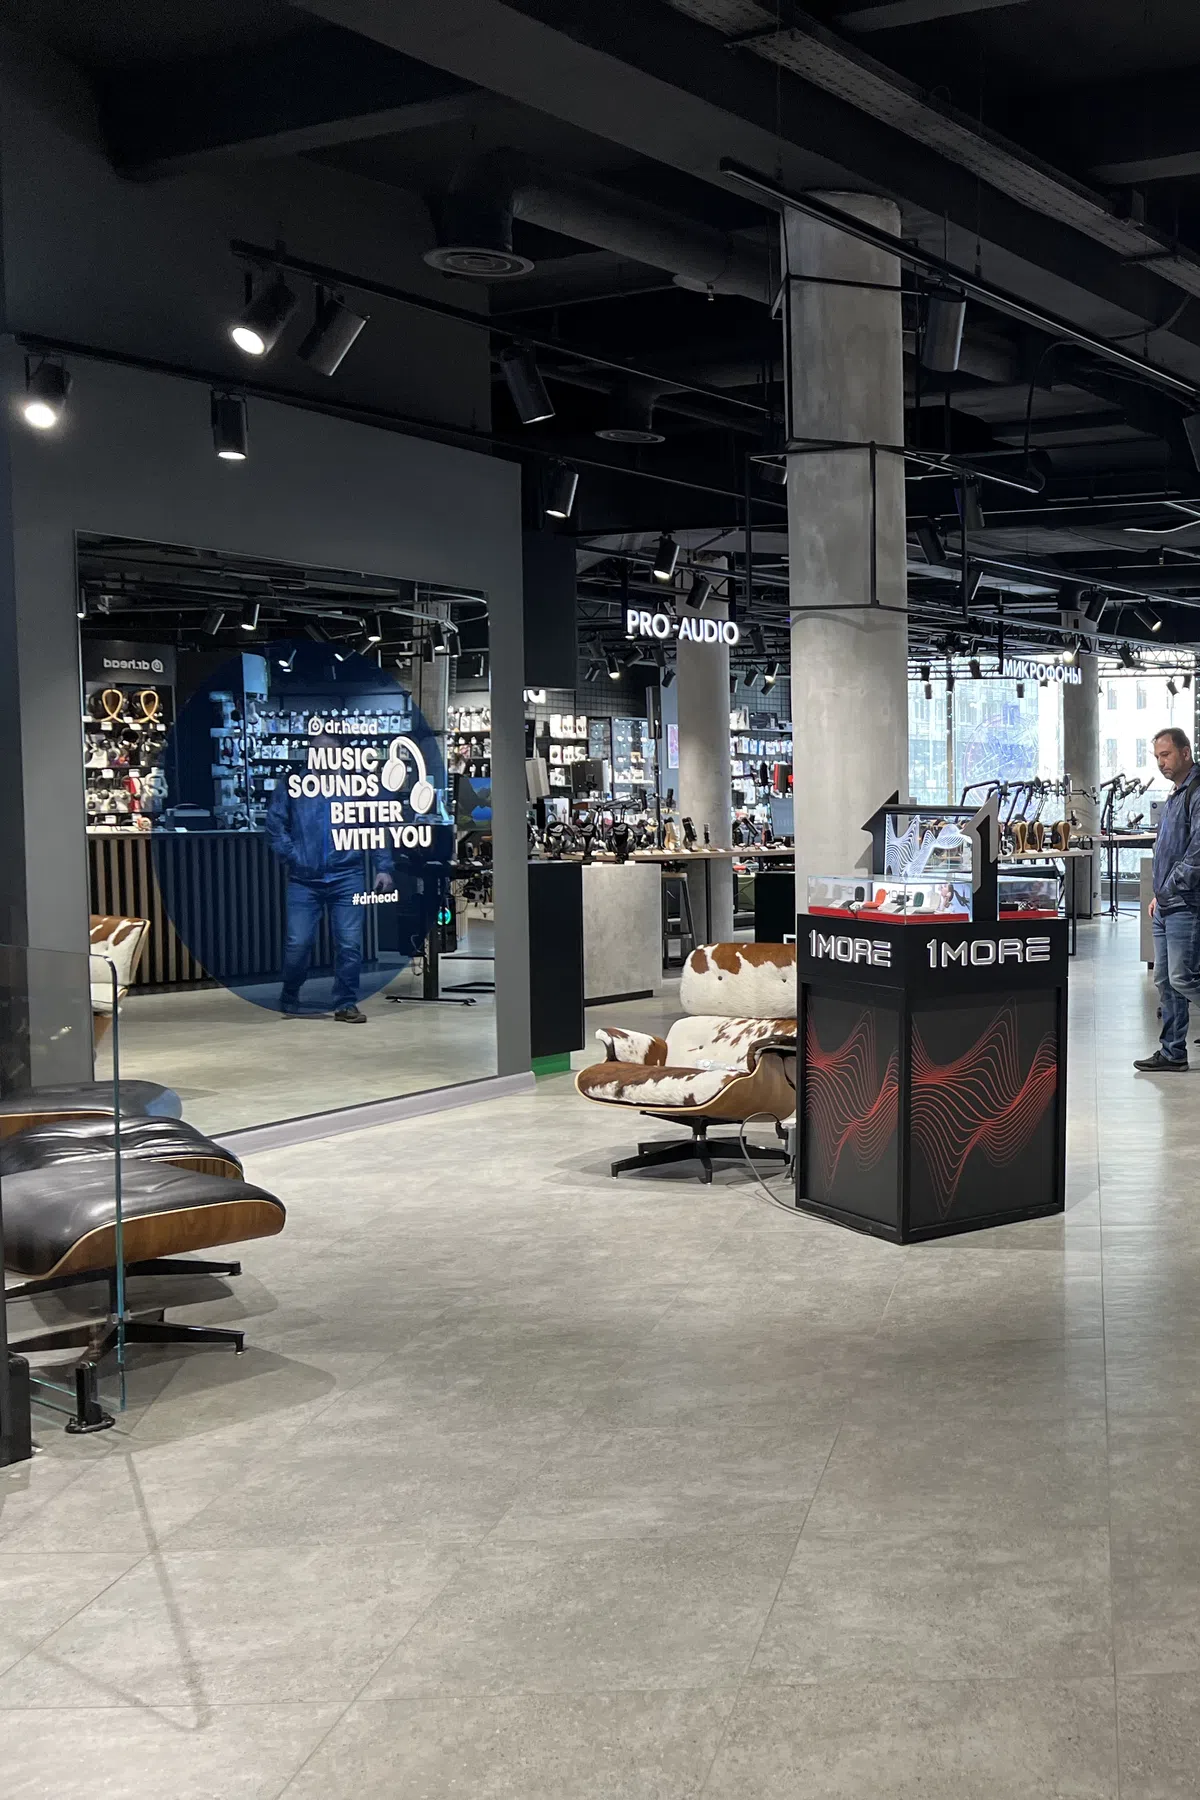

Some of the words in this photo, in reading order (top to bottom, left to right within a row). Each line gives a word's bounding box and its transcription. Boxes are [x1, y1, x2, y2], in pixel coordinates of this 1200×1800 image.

[626, 608, 740, 646] PRO-AUDIO
[1003, 658, 1082, 684] МИКРОФОНЫ
[324, 719, 378, 735] dr.head
[307, 747, 379, 771] MUSIC
[288, 774, 380, 799] SOUNDS
[330, 801, 404, 824] BETTER
[331, 827, 385, 851] WITH
[389, 825, 432, 848] YOU
[352, 889, 399, 905] #drhead
[808, 929, 892, 968] 1MORE
[926, 936, 1051, 968] 1MORE
